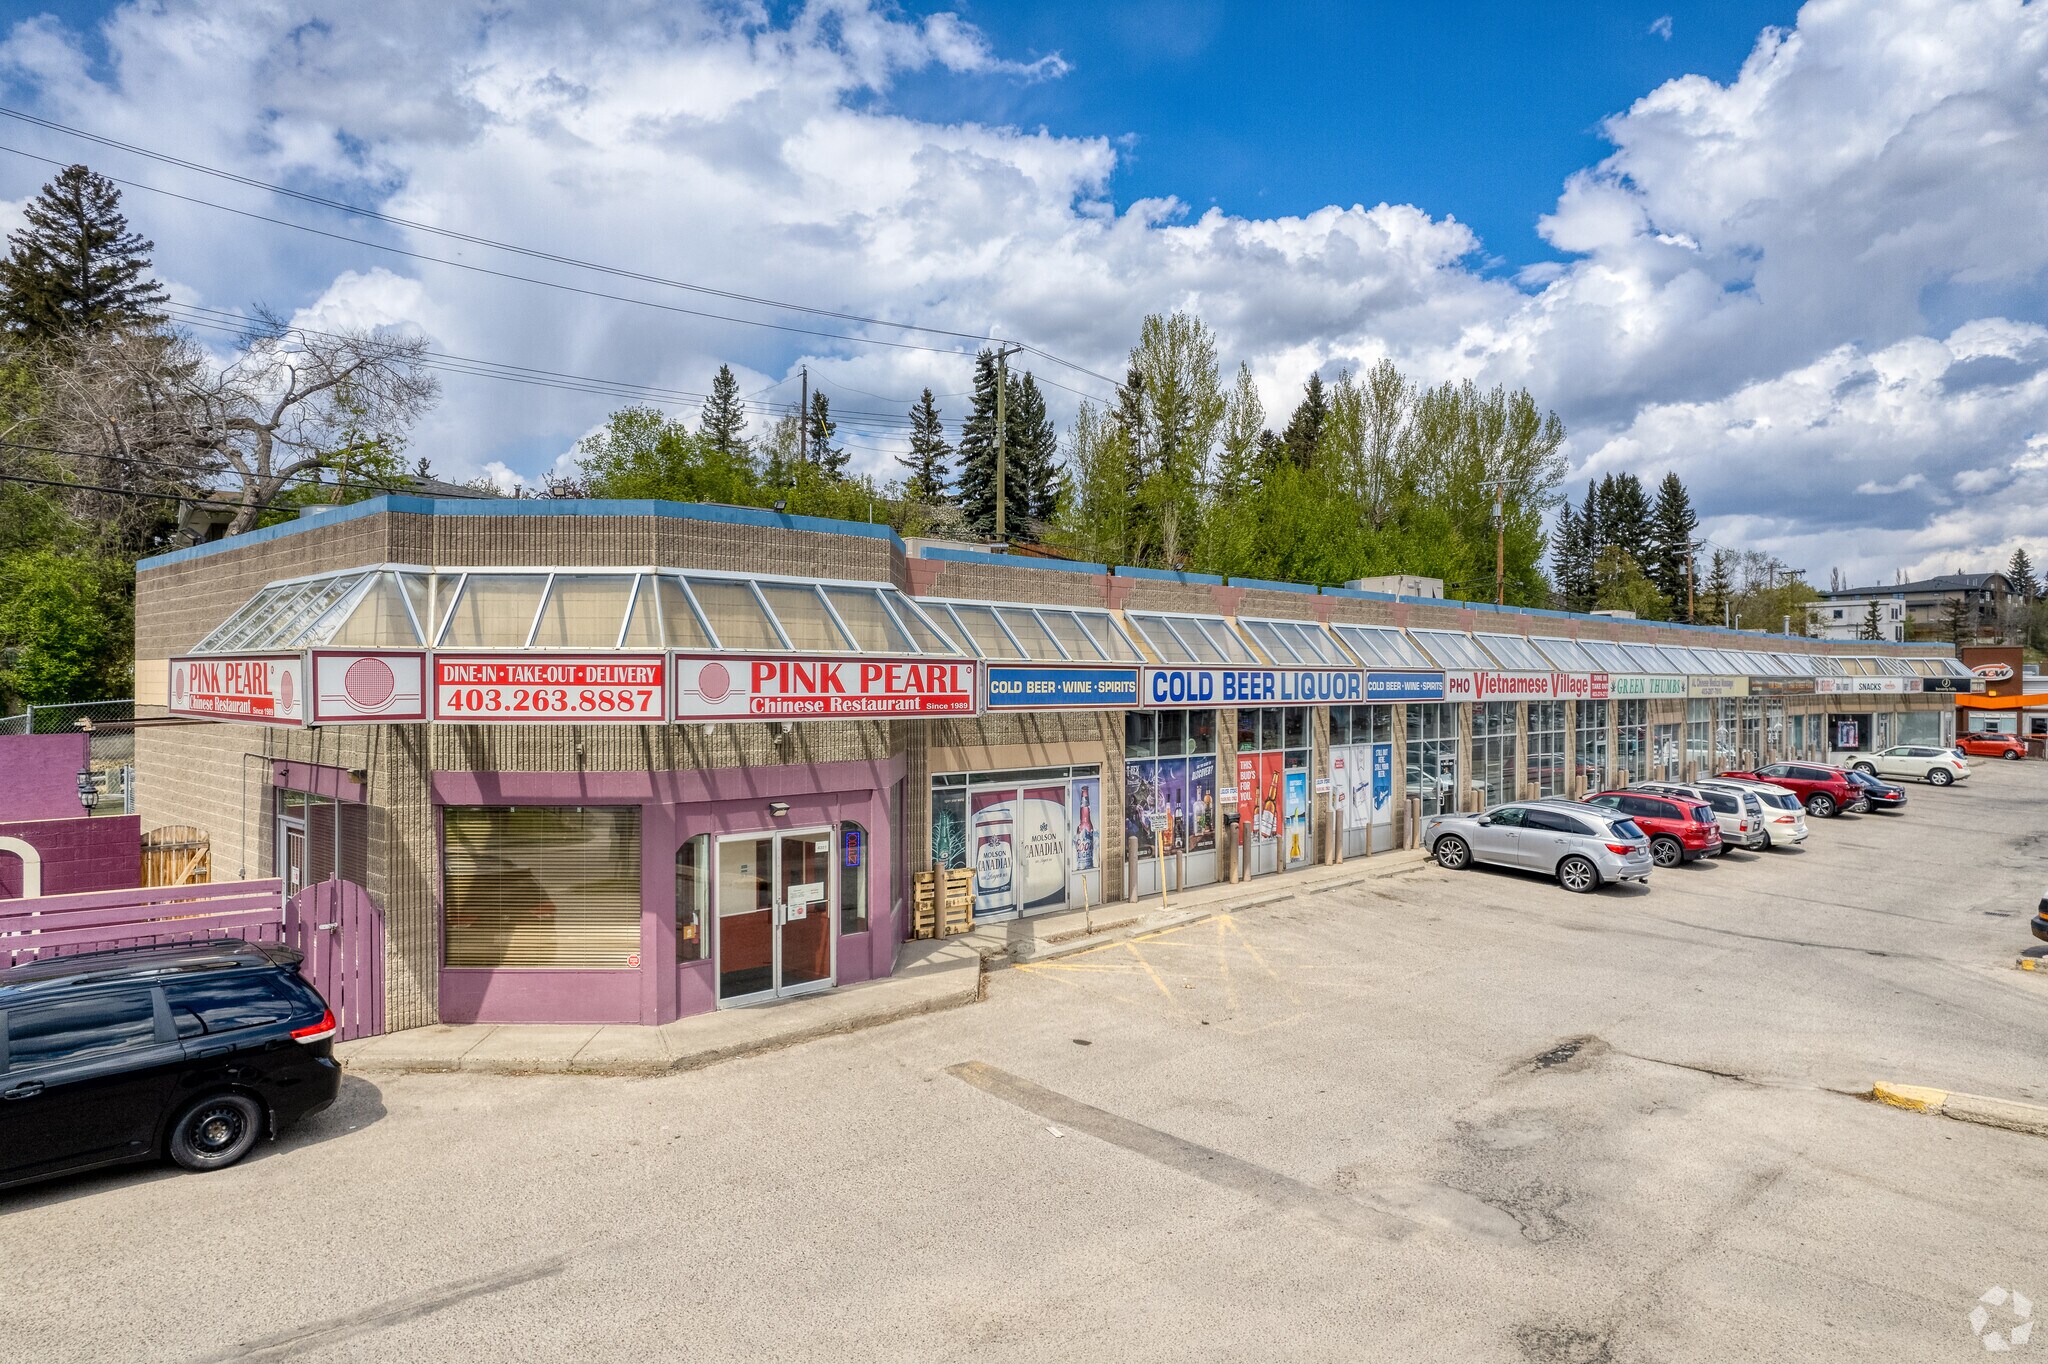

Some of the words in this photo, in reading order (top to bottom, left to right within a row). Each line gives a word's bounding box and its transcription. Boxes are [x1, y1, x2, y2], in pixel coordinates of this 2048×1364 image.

[189, 663, 221, 693] PINK
[225, 662, 273, 695] PEARL
[443, 665, 497, 683] DINE-IN
[506, 666, 577, 683] TAKE-OUT
[585, 666, 656, 683] DELIVERY
[751, 661, 847, 694] PINK
[860, 664, 968, 694] PEARL
[1977, 669, 2010, 677] A&W
[990, 680, 1022, 694] COLD
[1026, 680, 1056, 693] BEER
[1062, 680, 1092, 693] WINE
[1098, 680, 1136, 694] SPIRITS
[1152, 671, 1214, 702] COLD
[1223, 672, 1275, 701] BEER
[1281, 672, 1360, 700] LIQUOR
[1367, 681, 1385, 692] COLD
[1386, 681, 1402, 691] BEER
[1404, 681, 1420, 691] WINE
[1422, 681, 1443, 692] SPIRITS
[1449, 678, 1470, 693] PHO
[1473, 672, 1548, 699] Vietnamese
[1550, 673, 1588, 698] Village
[1617, 678, 1645, 695] GREEN
[1649, 678, 1681, 695] THUMBS
[1858, 683, 1882, 691] SNACKS
[189, 695, 214, 711] Chinese
[214, 697, 251, 714] Restaurant
[252, 707, 264, 715] Since
[447, 689, 653, 713] 403.263.8887
[750, 697, 825, 713] Chinese
[830, 696, 921, 712] Restaurant
[926, 702, 948, 710] Since
[950, 702, 968, 710] 1989
[1240, 760, 1253, 770] THIS
[1240, 770, 1256, 780] BUD'S
[1240, 781, 1251, 791] FOR
[1240, 791, 1252, 801] YOU.
[1031, 833, 1057, 842] MOLSON
[848, 834, 857, 865] OPEN
[983, 850, 1007, 858] MOLSON
[1024, 840, 1063, 859] CANADIAN
